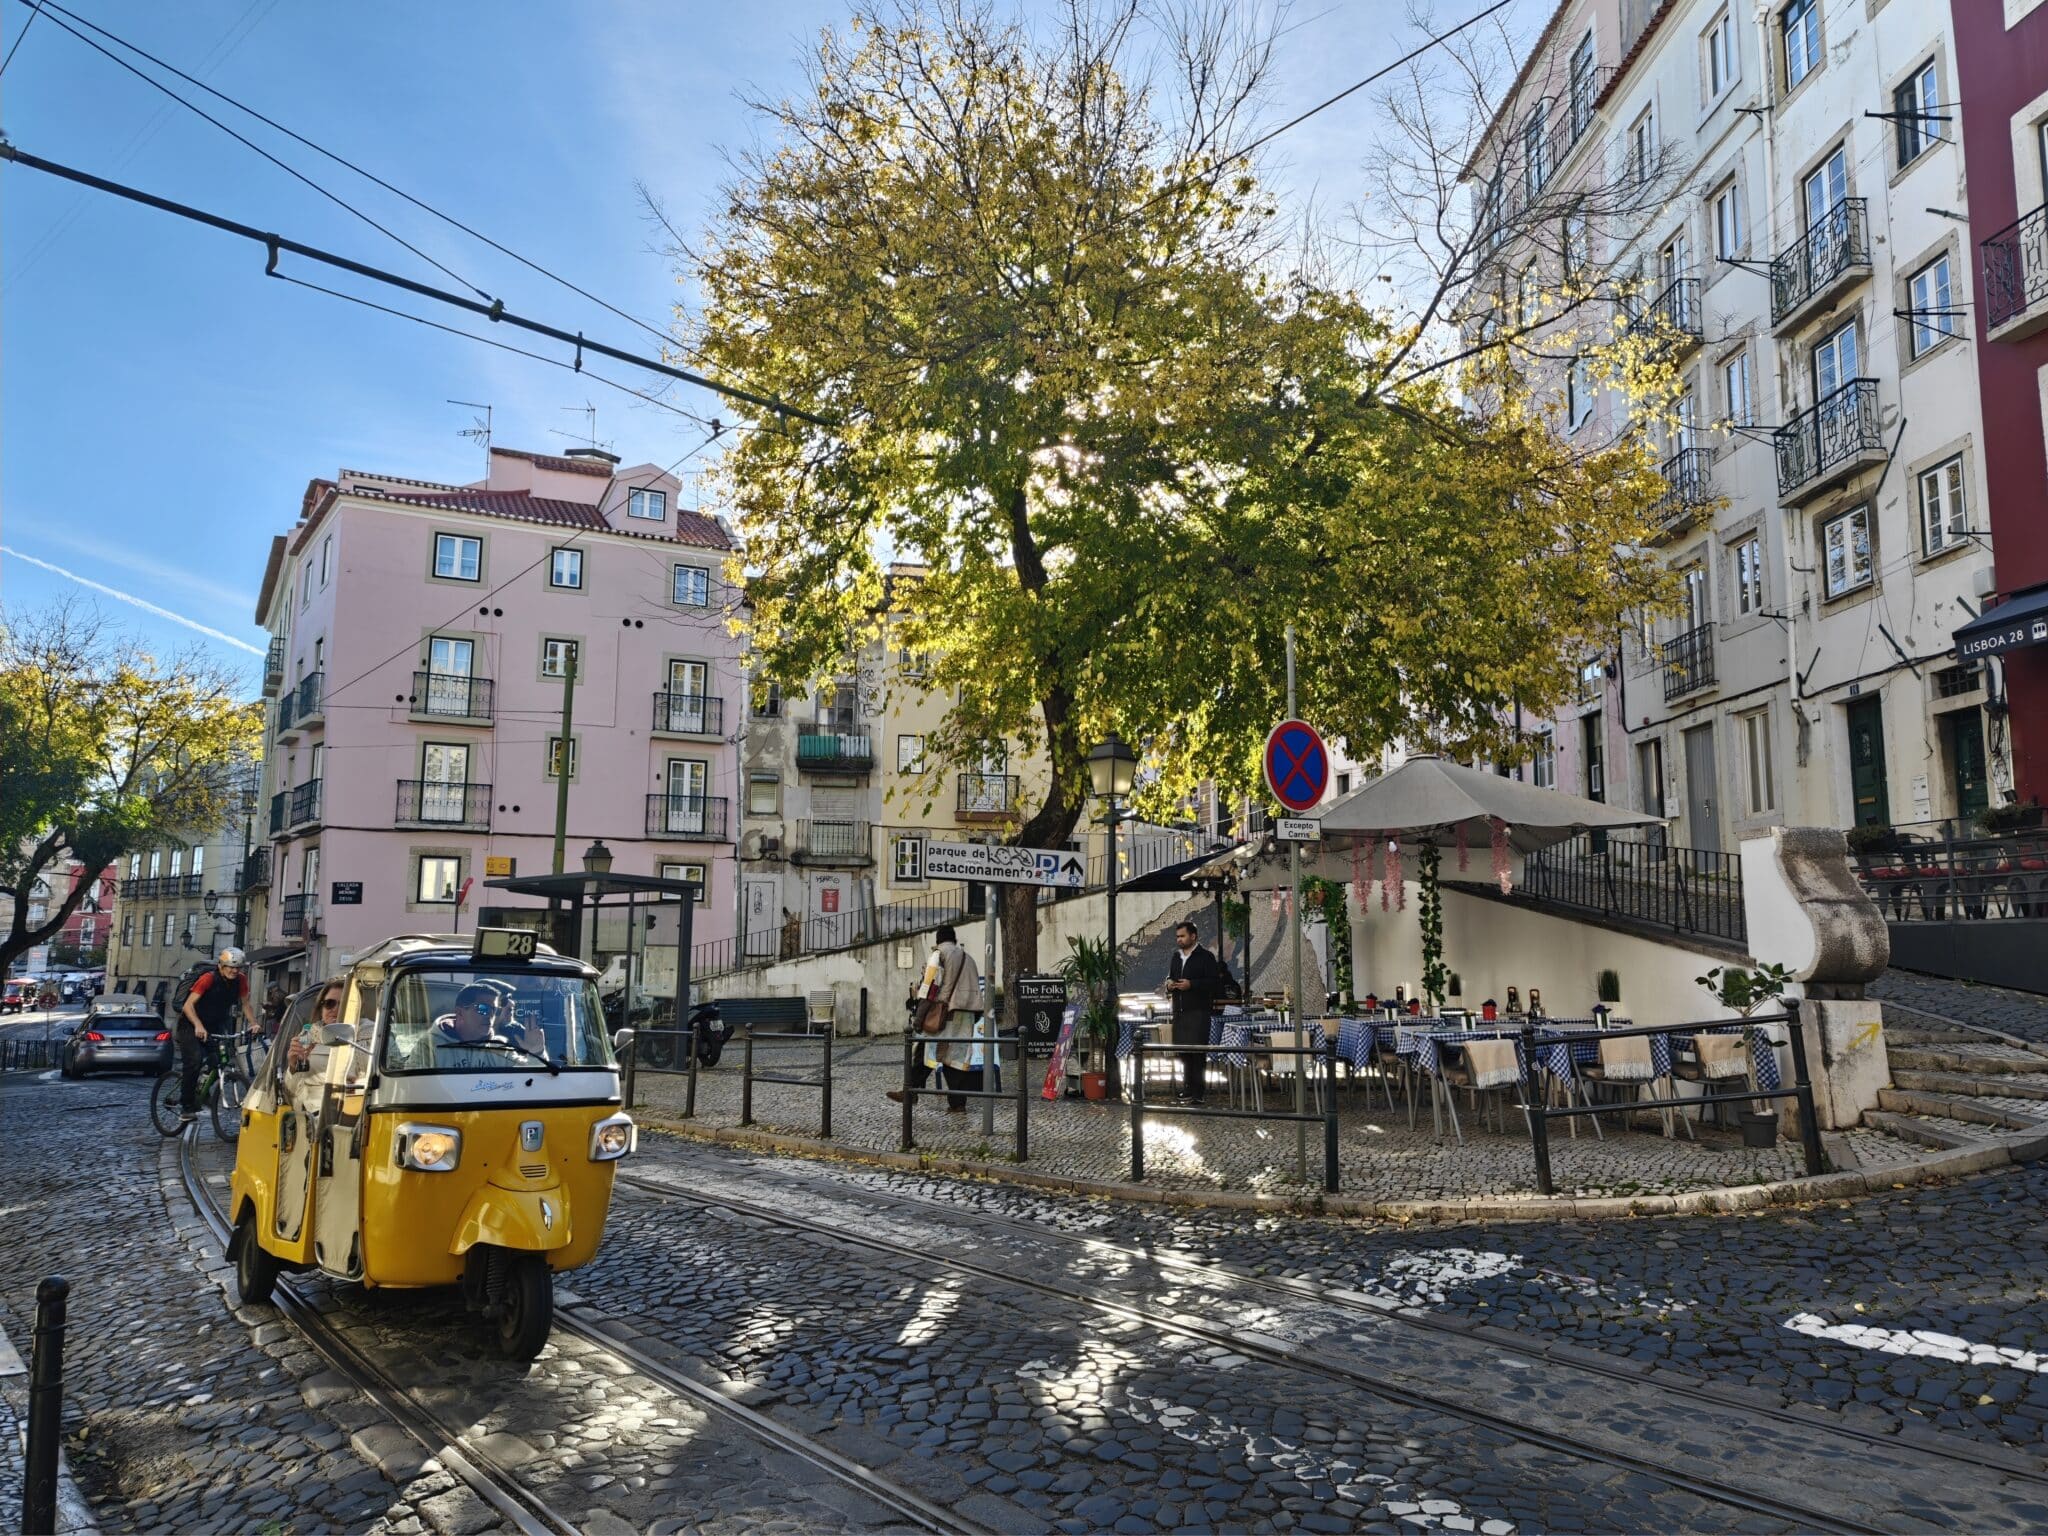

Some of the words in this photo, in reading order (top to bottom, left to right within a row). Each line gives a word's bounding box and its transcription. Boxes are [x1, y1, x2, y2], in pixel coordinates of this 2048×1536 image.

[1963, 635, 2006, 655] LISBOA
[2009, 629, 2024, 643] 28
[1284, 821, 1314, 830] Excepto
[928, 846, 967, 858] parque
[972, 848, 985, 859] de
[928, 860, 1033, 879] estacionamento
[1040, 855, 1056, 873] P
[507, 934, 533, 955] 28
[1020, 985, 1039, 994] The
[1041, 984, 1064, 994] Folks
